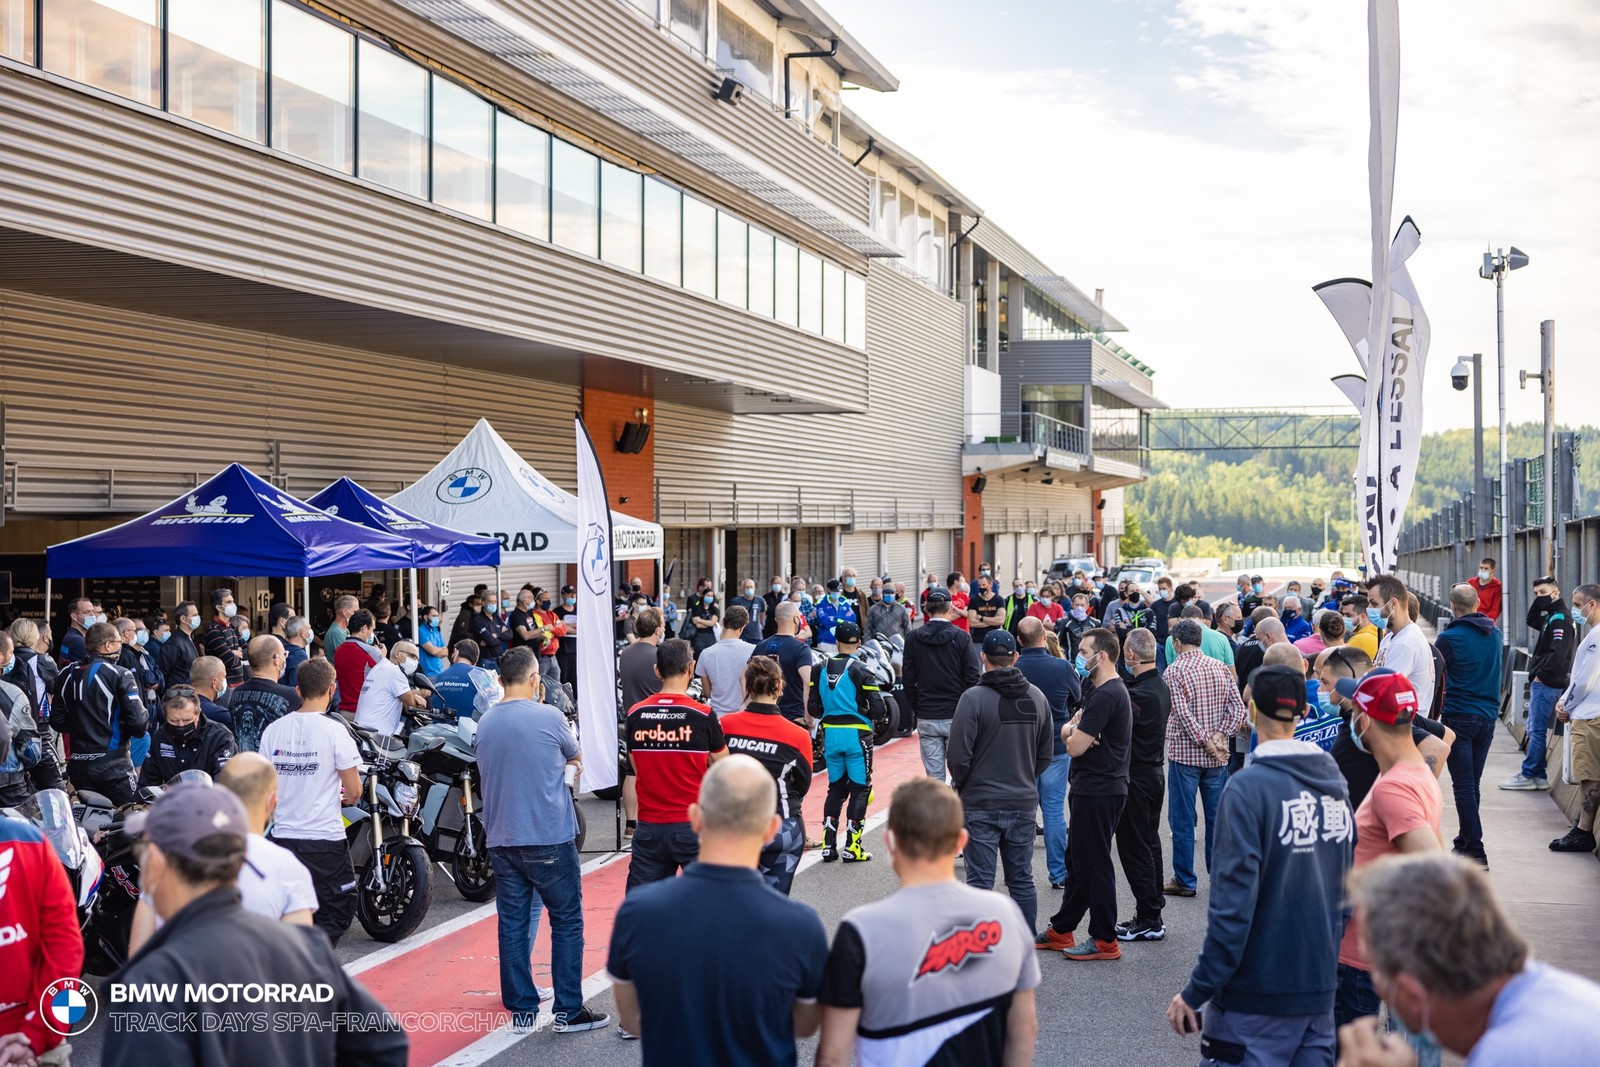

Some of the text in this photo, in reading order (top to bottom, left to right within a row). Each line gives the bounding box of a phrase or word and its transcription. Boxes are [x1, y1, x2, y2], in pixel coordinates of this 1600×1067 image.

[449, 470, 487, 481] BMW
[150, 516, 250, 526] MICHELIN
[285, 516, 332, 524] MICHELIN
[614, 530, 656, 549] MOTORRAD
[442, 581, 450, 593] 15
[257, 592, 269, 609] 16
[634, 724, 693, 742] aruba.it
[728, 737, 778, 754] DUCATI
[1278, 791, 1353, 846] 感動
